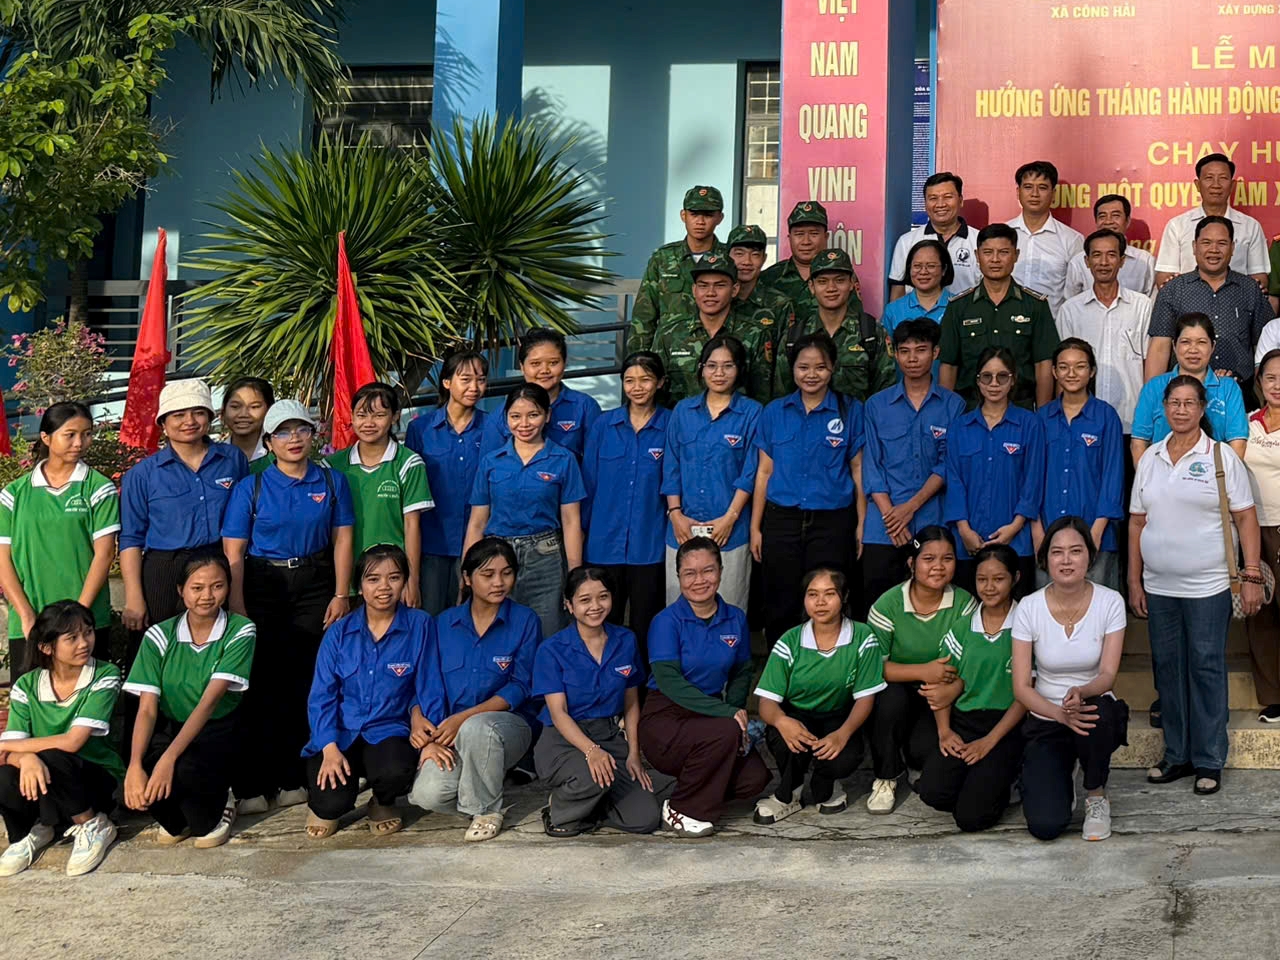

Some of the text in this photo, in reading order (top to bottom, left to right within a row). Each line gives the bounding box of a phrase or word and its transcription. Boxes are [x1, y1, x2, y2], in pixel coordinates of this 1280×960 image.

[1050, 2, 1136, 19] XÃ CÔNG HẢI
[1218, 2, 1241, 16] XÂY
[1243, 3, 1275, 18] DỰNG
[810, 41, 858, 77] NAM
[1191, 34, 1236, 70] LỄ
[975, 80, 1044, 118] HƯỞNG
[1049, 82, 1091, 117] ỨNG
[1096, 82, 1162, 116] THÁNG
[1167, 82, 1222, 115] HÀNH
[798, 103, 868, 142] QUANG
[808, 167, 857, 202] VINH
[1233, 176, 1268, 206] ÂM
